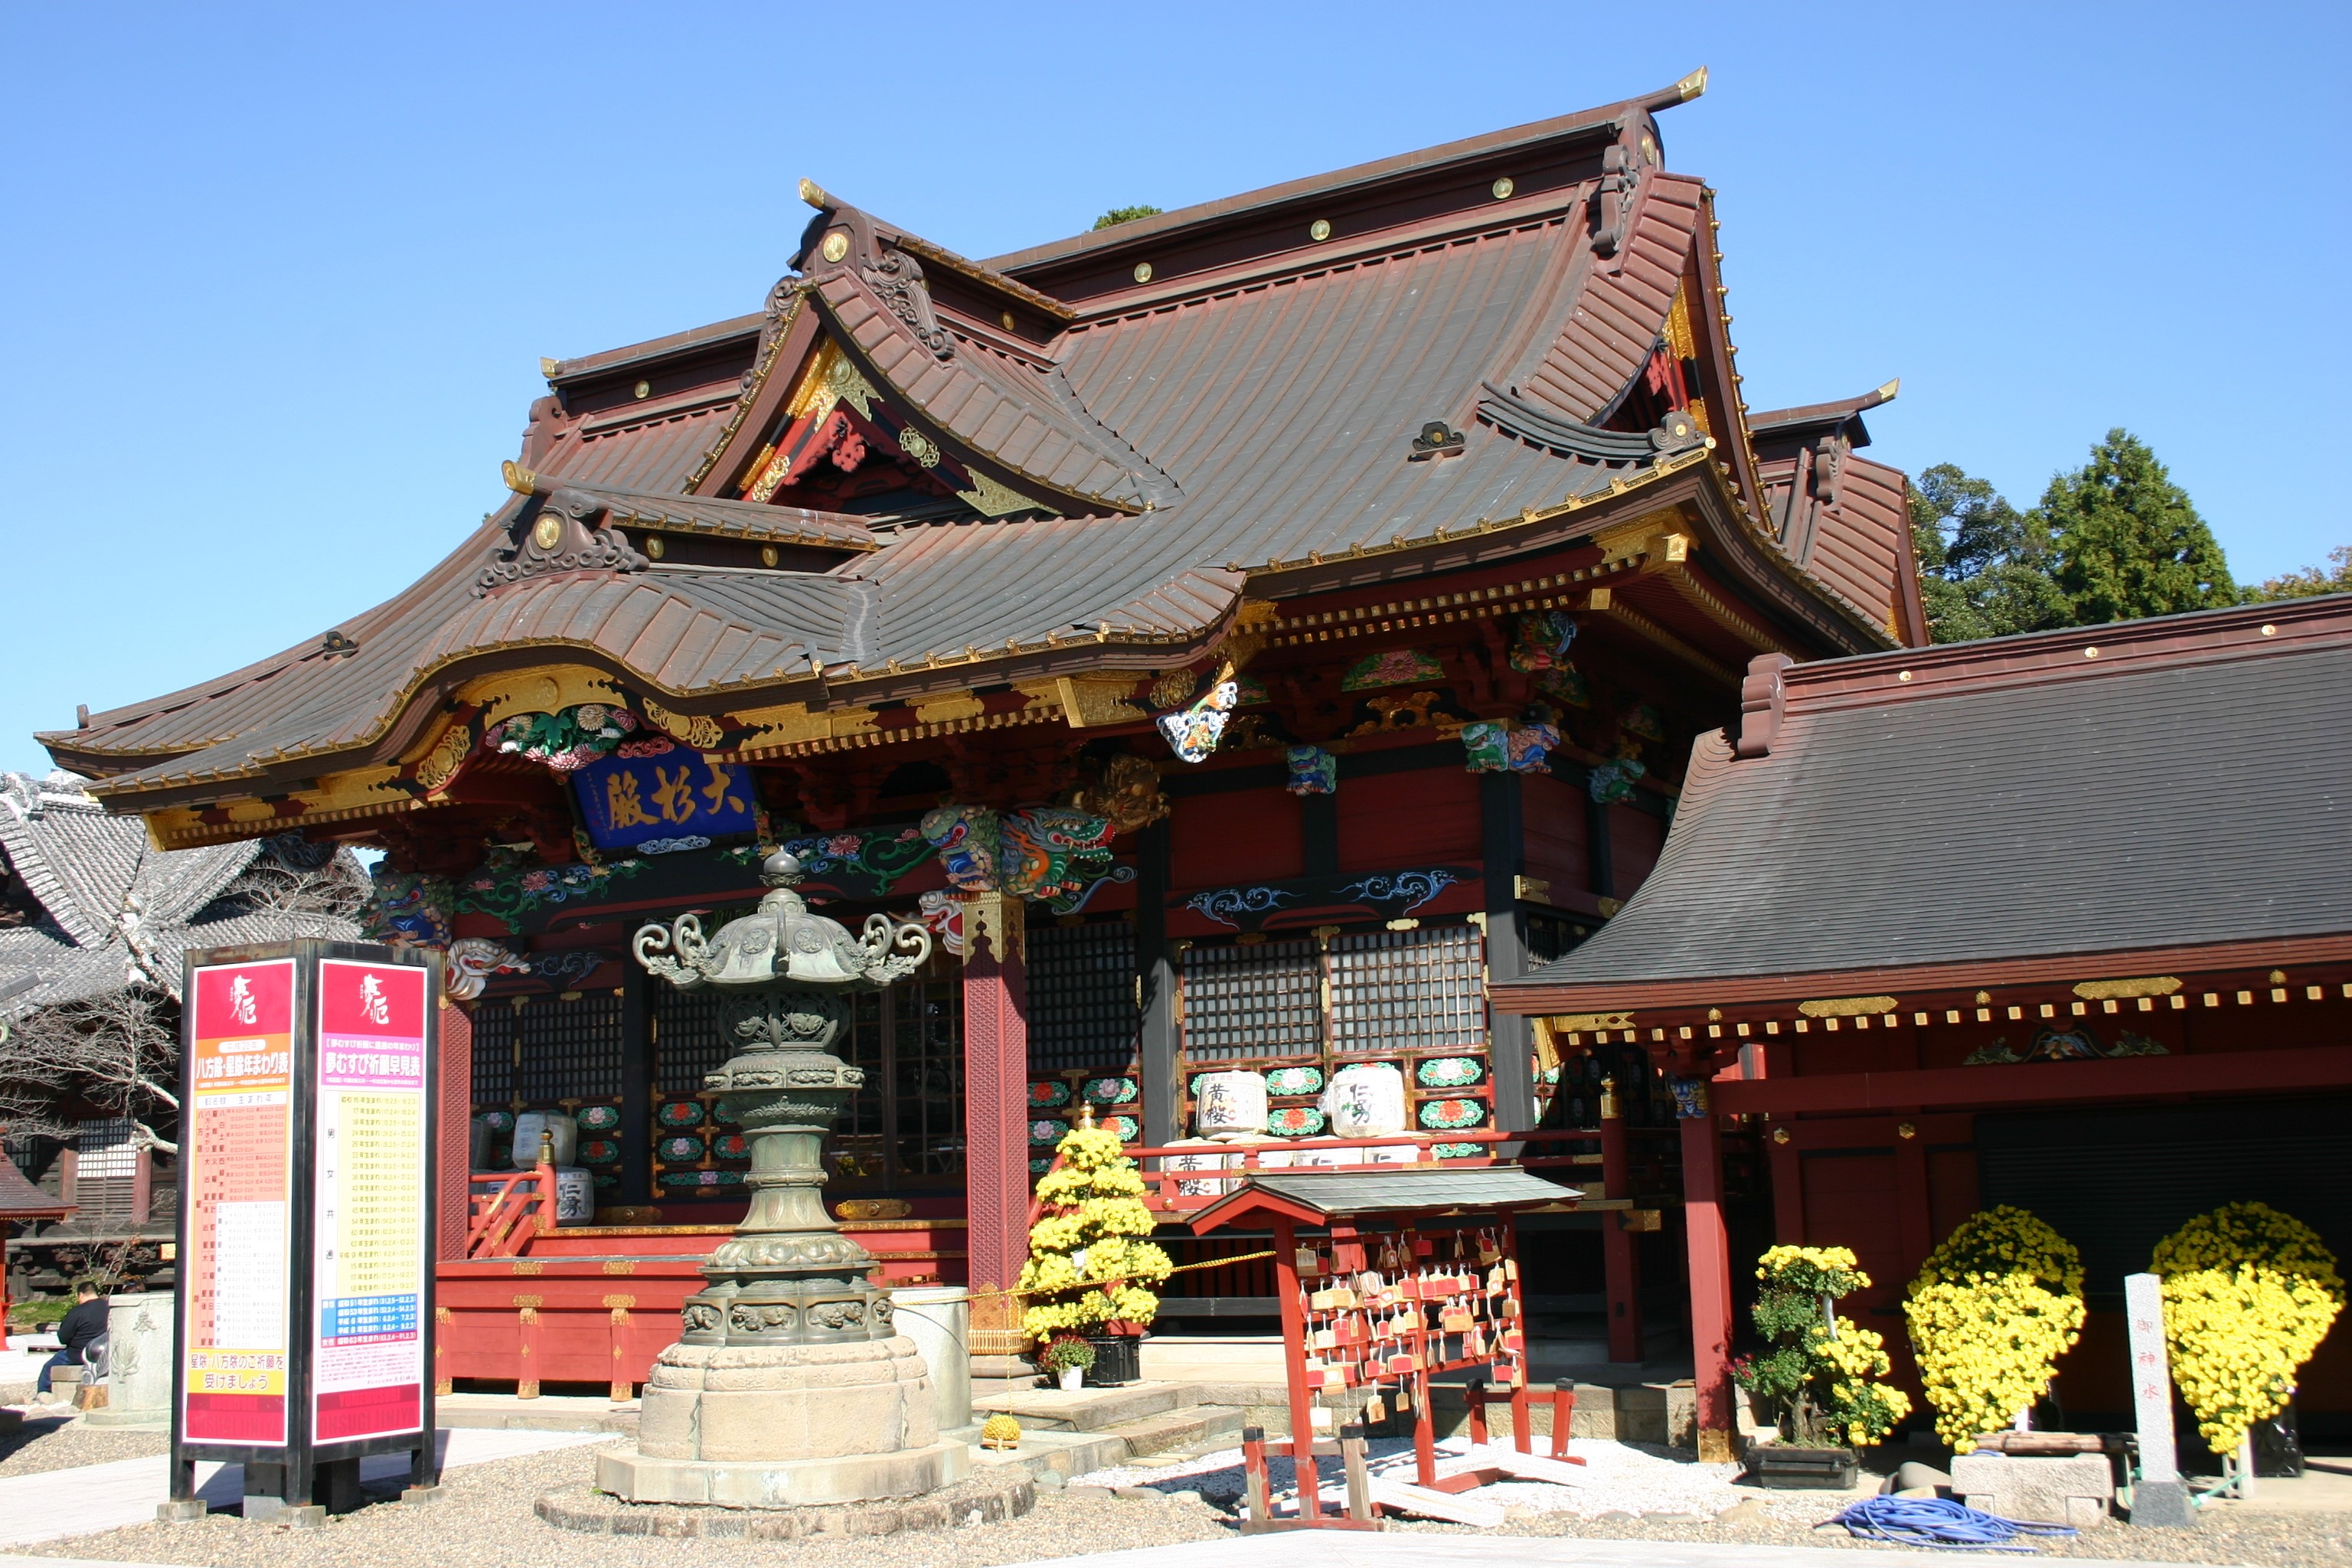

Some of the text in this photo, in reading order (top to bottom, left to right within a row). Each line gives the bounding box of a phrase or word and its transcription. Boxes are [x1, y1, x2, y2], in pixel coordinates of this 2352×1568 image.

[196, 1051, 289, 1080] 八方除・星除年まわり表
[325, 1051, 420, 1077] 夢むすび祈願早見表
[2135, 1318, 2160, 1400] 御神水
[204, 1374, 268, 1390] 受けましょう
